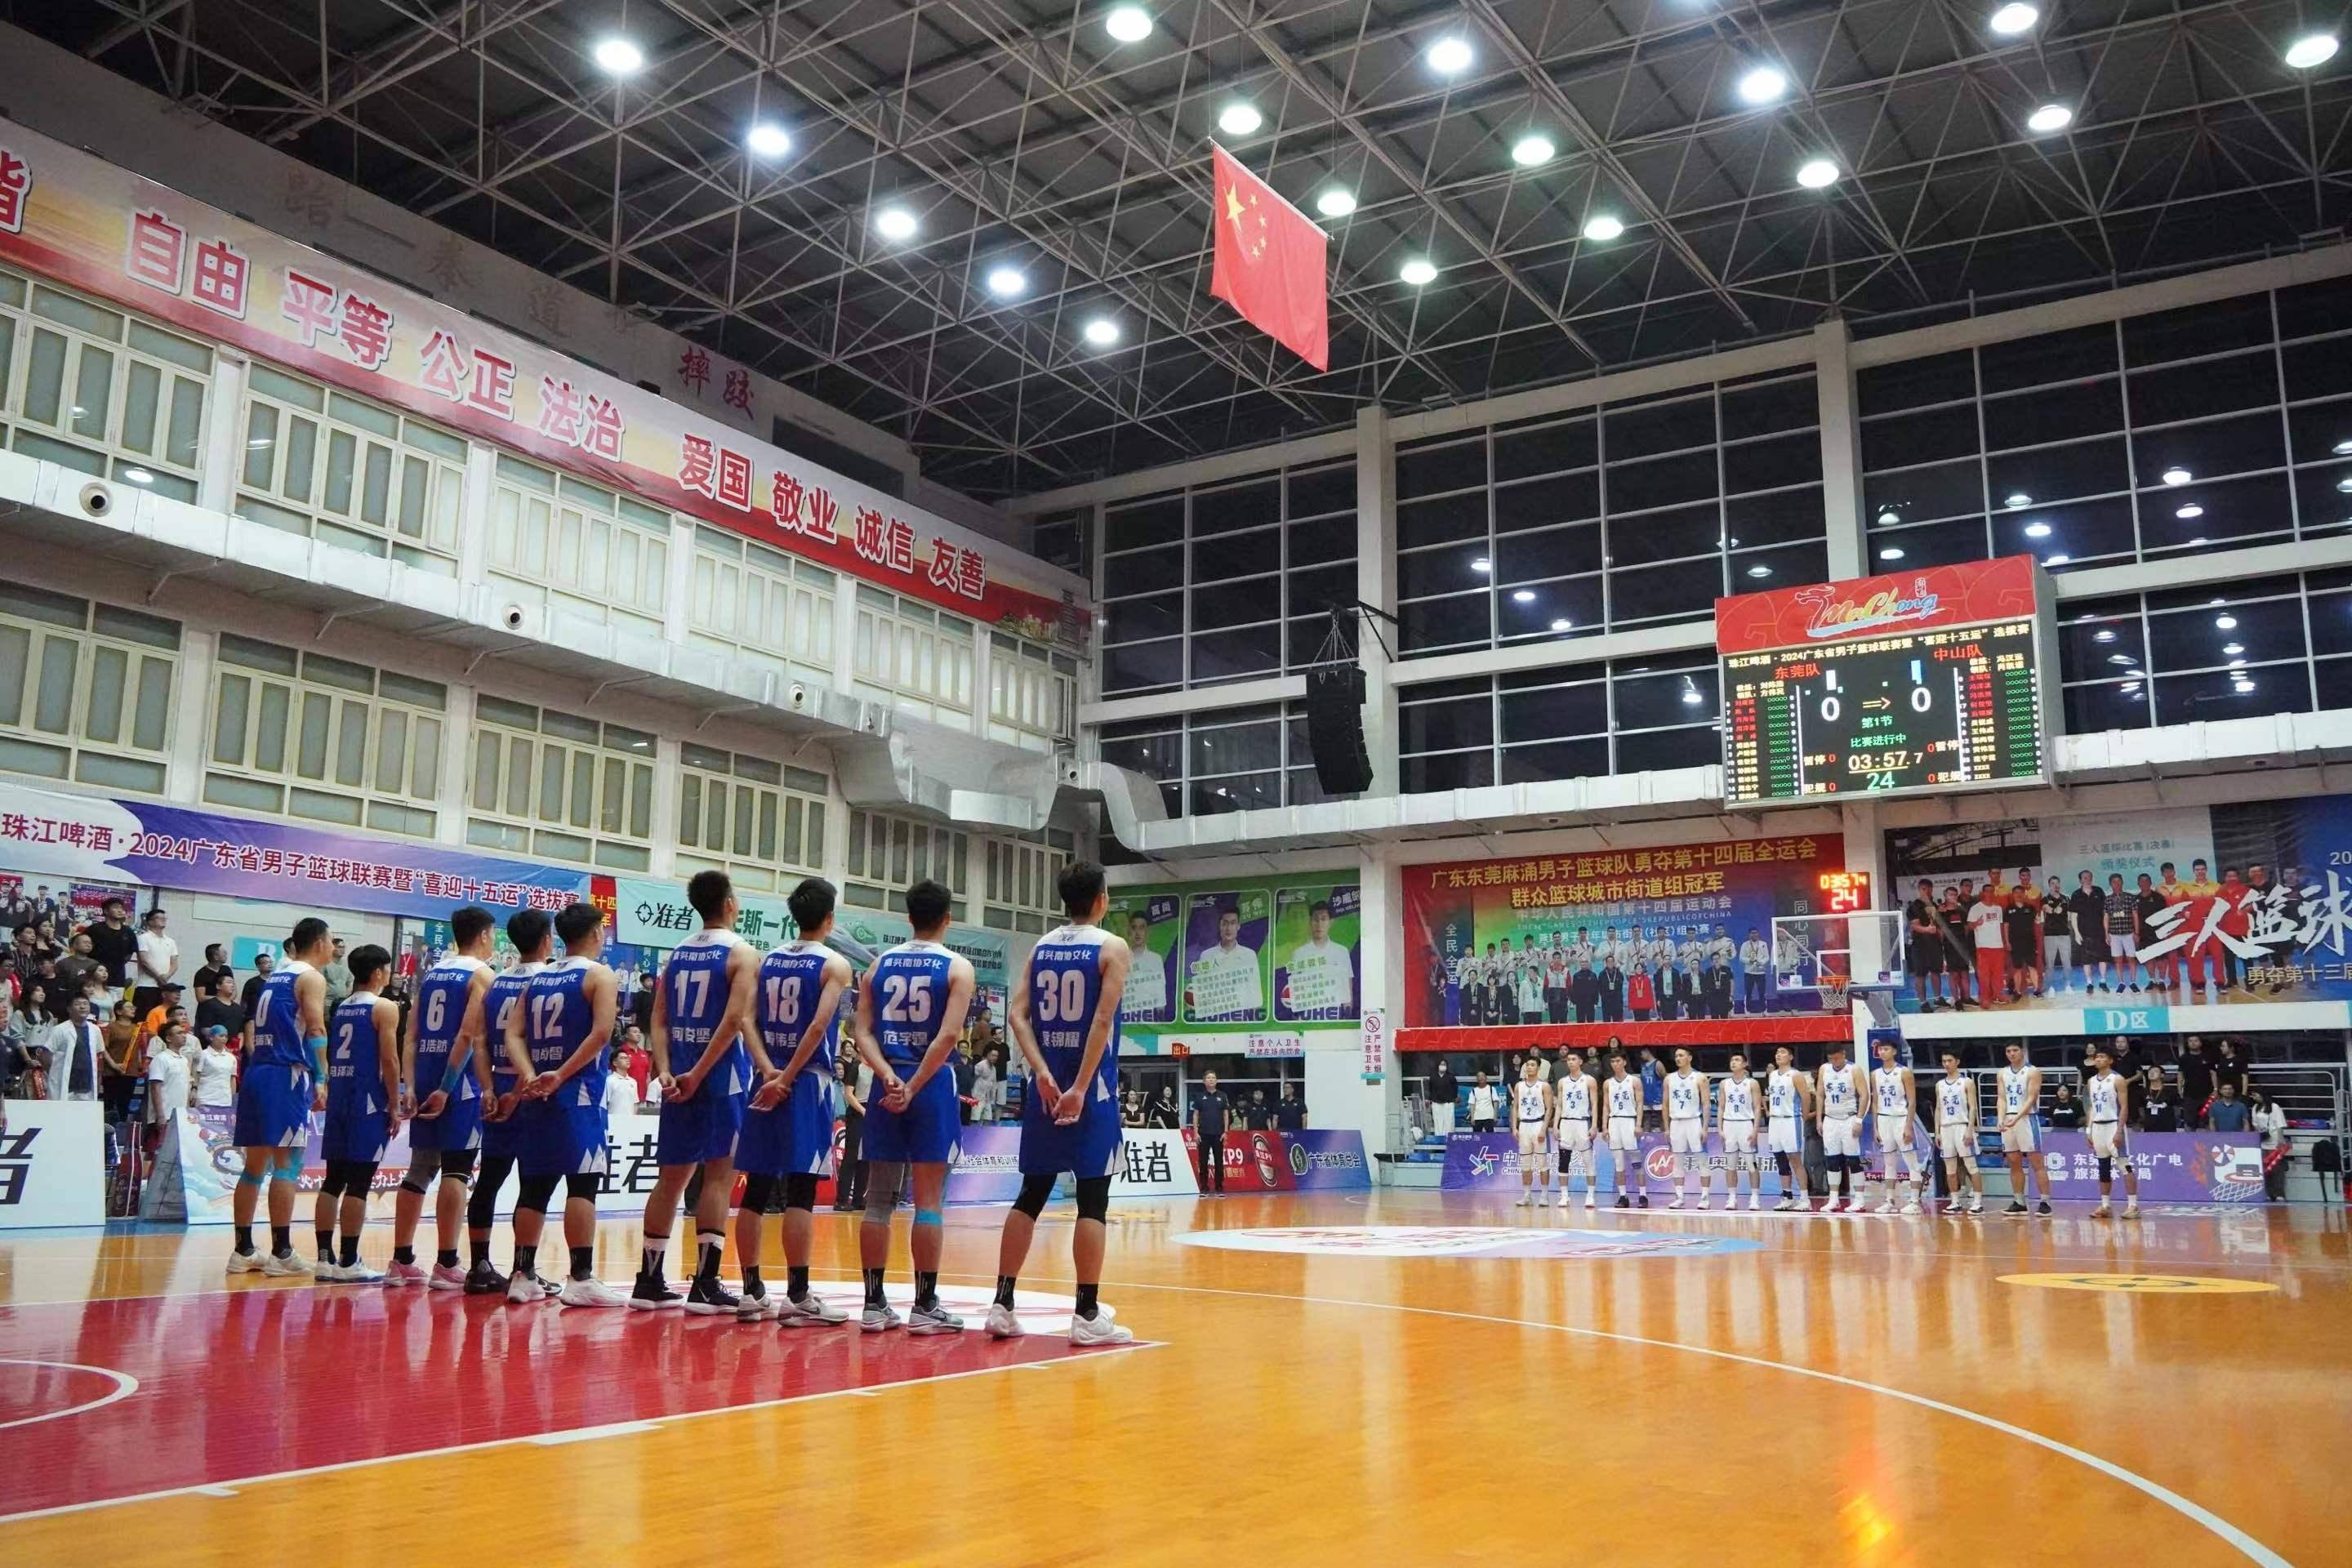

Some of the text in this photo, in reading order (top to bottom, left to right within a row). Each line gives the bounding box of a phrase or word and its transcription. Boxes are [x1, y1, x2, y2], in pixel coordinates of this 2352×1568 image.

[679, 345, 755, 420] 摔跤
[130, 208, 985, 599] 自由 平等 公正 法治 爱国 敬业 诚信 友善
[1934, 644, 1983, 662] 中山队
[1775, 663, 1821, 680] 东莞队
[1911, 687, 1931, 712] 0
[1821, 697, 1840, 722] 0
[1861, 715, 1893, 728] 第1节
[1851, 733, 1907, 747] 比赛进行中
[1927, 743, 1935, 753] 0
[1803, 754, 1836, 766] 暂停 0
[1829, 782, 1836, 791] 0
[1866, 771, 1895, 791] 24
[1927, 773, 1936, 783] 0
[1432, 838, 1817, 889] 广东东莞麻涌男子篮球队勇夺第十四届全运会
[1512, 871, 1725, 907] 群众篮球城市街道组冠军
[1831, 889, 1858, 910] 24
[652, 902, 695, 931] 准者
[2135, 870, 2352, 964] 三人篮球
[674, 969, 711, 1018] 17
[765, 976, 801, 1024] 18
[882, 975, 931, 1022] 25
[1036, 969, 1085, 1022] 30
[255, 989, 273, 1027] 0
[426, 989, 447, 1031] 6
[496, 996, 518, 1031] 4
[532, 992, 565, 1040] 12
[336, 1023, 354, 1059] 2
[1249, 1038, 1301, 1048] 注意个人卫生
[1172, 1045, 1191, 1057] 出口
[1249, 1048, 1301, 1057] 严禁在场内饮食
[1374, 1035, 1382, 1073] 严禁吸烟
[1570, 1101, 1575, 1109] 3
[1678, 1101, 1685, 1110] 7
[1772, 1097, 1780, 1106] 10
[1831, 1094, 1840, 1103] 11
[1883, 1098, 1891, 1107] 12
[2010, 1096, 2017, 1106] 15
[1526, 1107, 1531, 1116] 2
[1947, 1107, 1954, 1116] 13
[1307, 1151, 1361, 1169] 广东省体育总会
[2073, 1152, 2183, 1166] 东莞文化广电
[2074, 1167, 2152, 1181] 旅游体局
